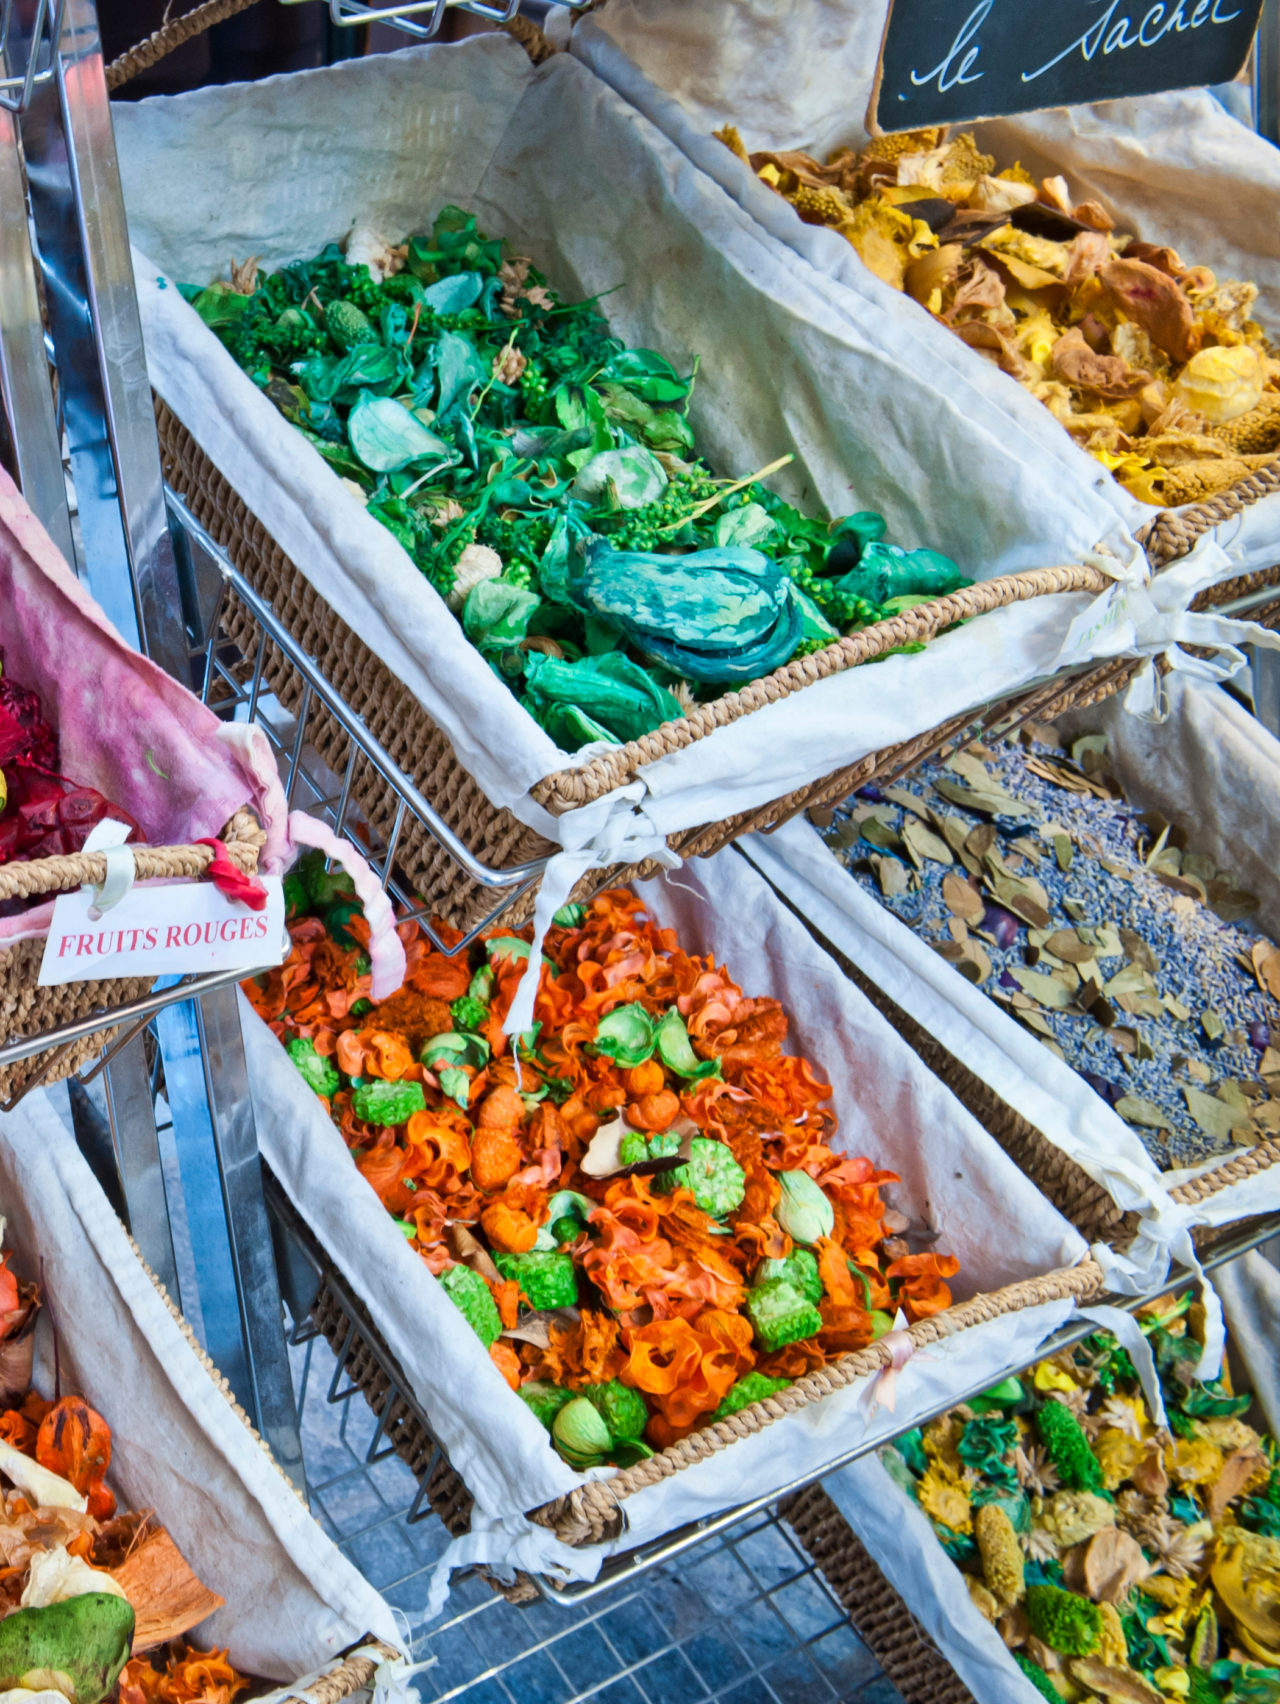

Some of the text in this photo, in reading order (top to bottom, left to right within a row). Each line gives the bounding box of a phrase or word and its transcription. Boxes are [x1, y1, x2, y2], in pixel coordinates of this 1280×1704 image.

[910, 0, 985, 93] le
[57, 915, 268, 957] FRUITS ROUGES
